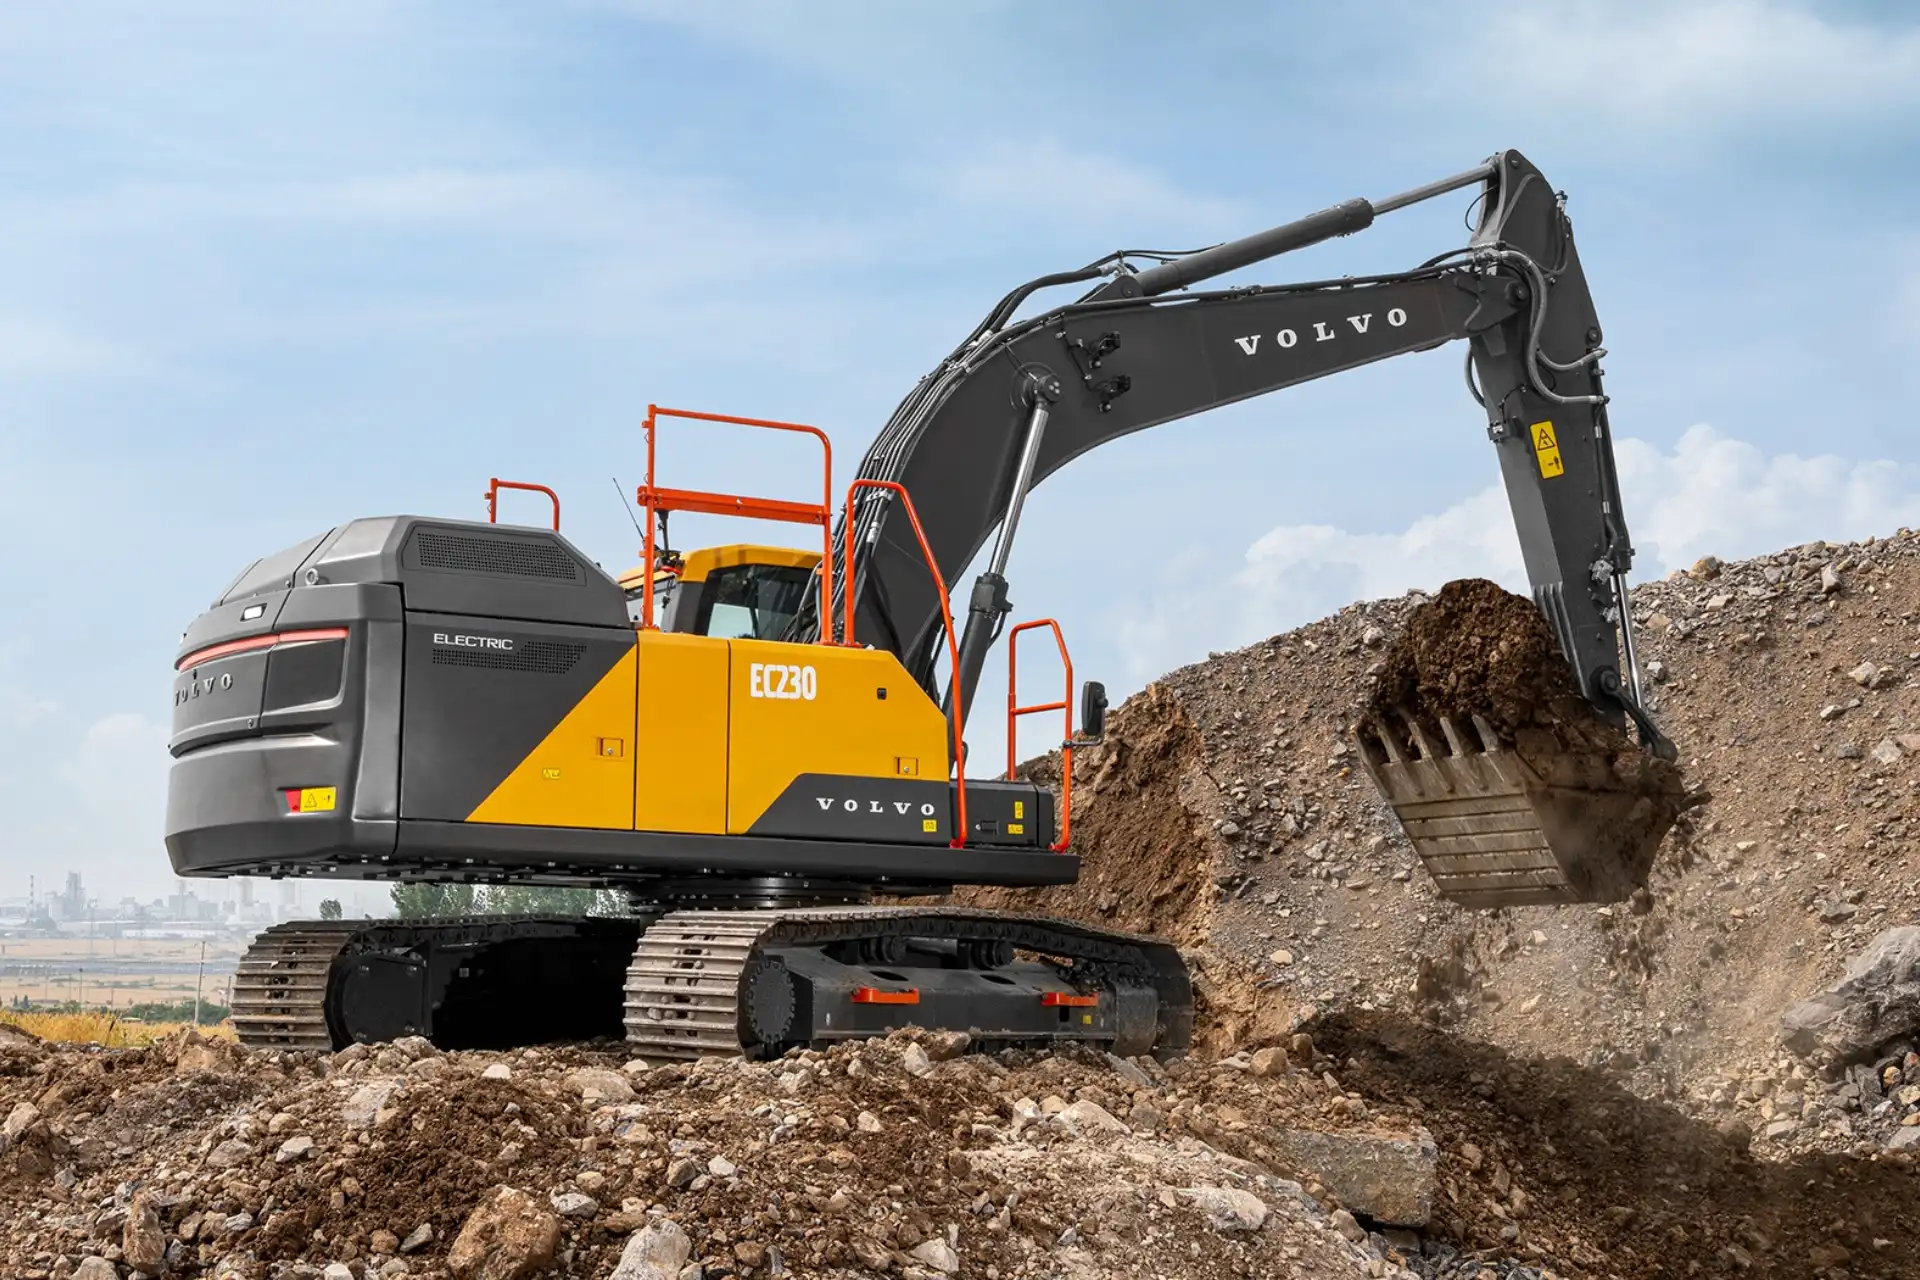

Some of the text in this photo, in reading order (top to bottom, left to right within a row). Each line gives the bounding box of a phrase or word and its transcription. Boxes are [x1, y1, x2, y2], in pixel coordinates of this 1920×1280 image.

[1234, 307, 1407, 355] VOLVO
[433, 633, 514, 650] ELECTRIC
[750, 662, 817, 701] EC230
[815, 797, 935, 816] VOLVO
